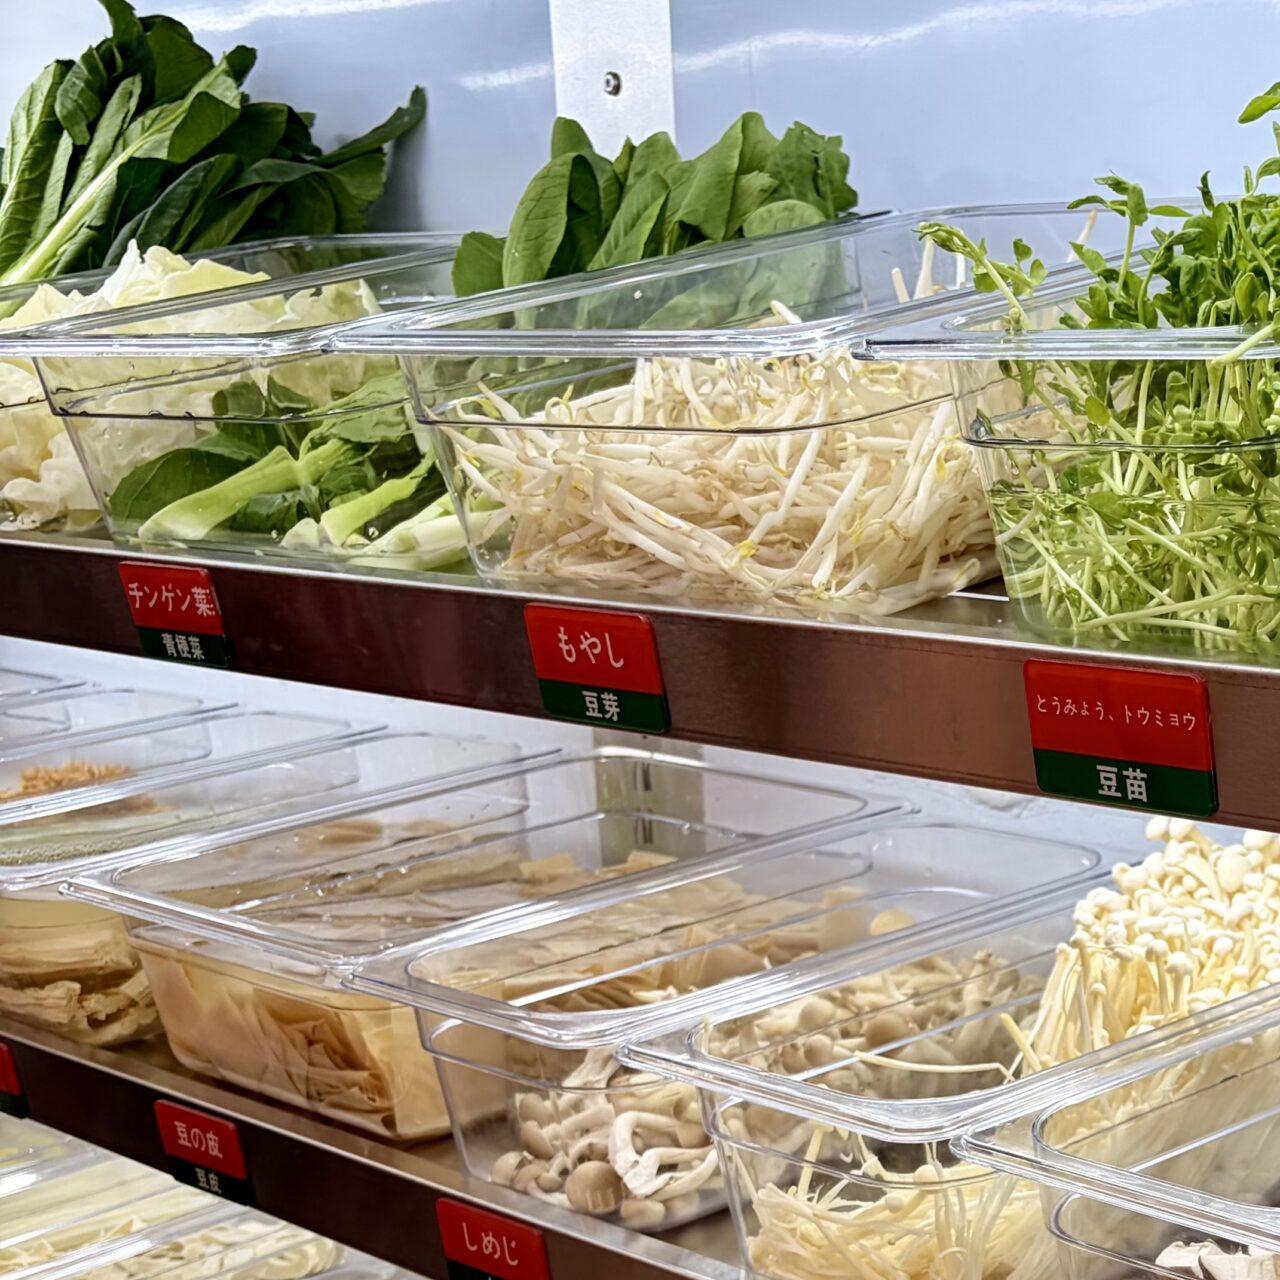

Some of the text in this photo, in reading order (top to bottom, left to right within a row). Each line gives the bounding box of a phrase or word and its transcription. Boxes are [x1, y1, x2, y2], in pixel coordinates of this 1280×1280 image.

[558, 625, 624, 668] もやし
[582, 690, 620, 721] 豆芽
[1096, 764, 1148, 802] 豆苗
[173, 1120, 223, 1159] 豆の皮
[462, 1222, 518, 1266] しめじ
